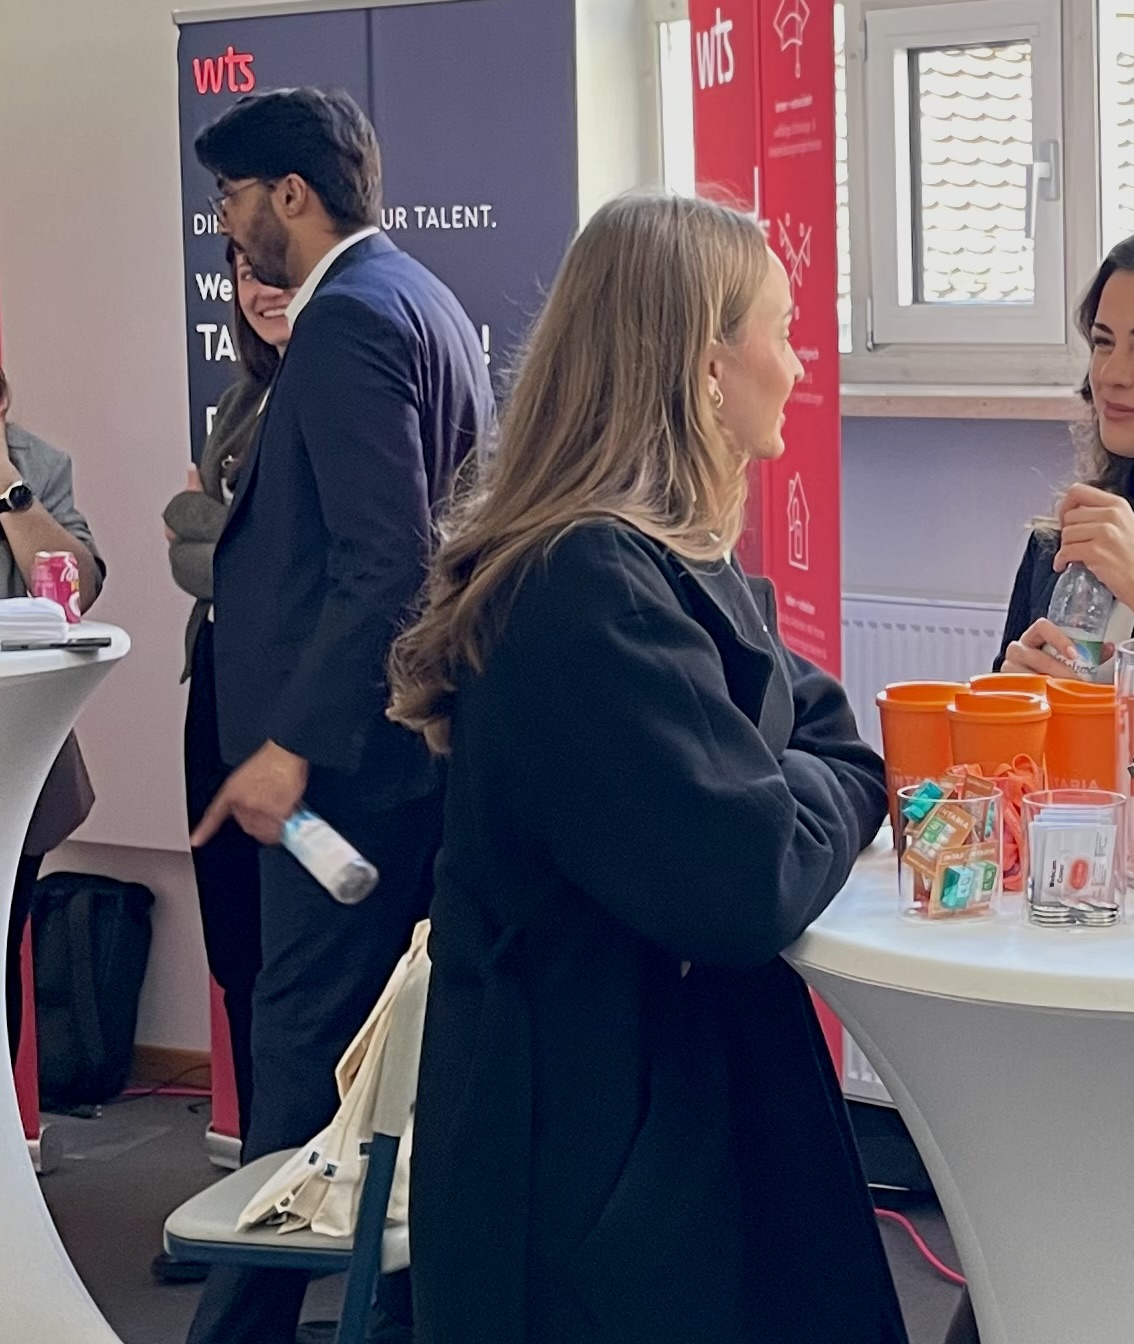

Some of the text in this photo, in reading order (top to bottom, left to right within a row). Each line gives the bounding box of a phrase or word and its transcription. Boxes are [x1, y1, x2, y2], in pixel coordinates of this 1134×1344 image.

[193, 45, 256, 94] wts
[696, 7, 734, 90] wts
[413, 204, 498, 229] TALENT.
[196, 323, 241, 362] TA
